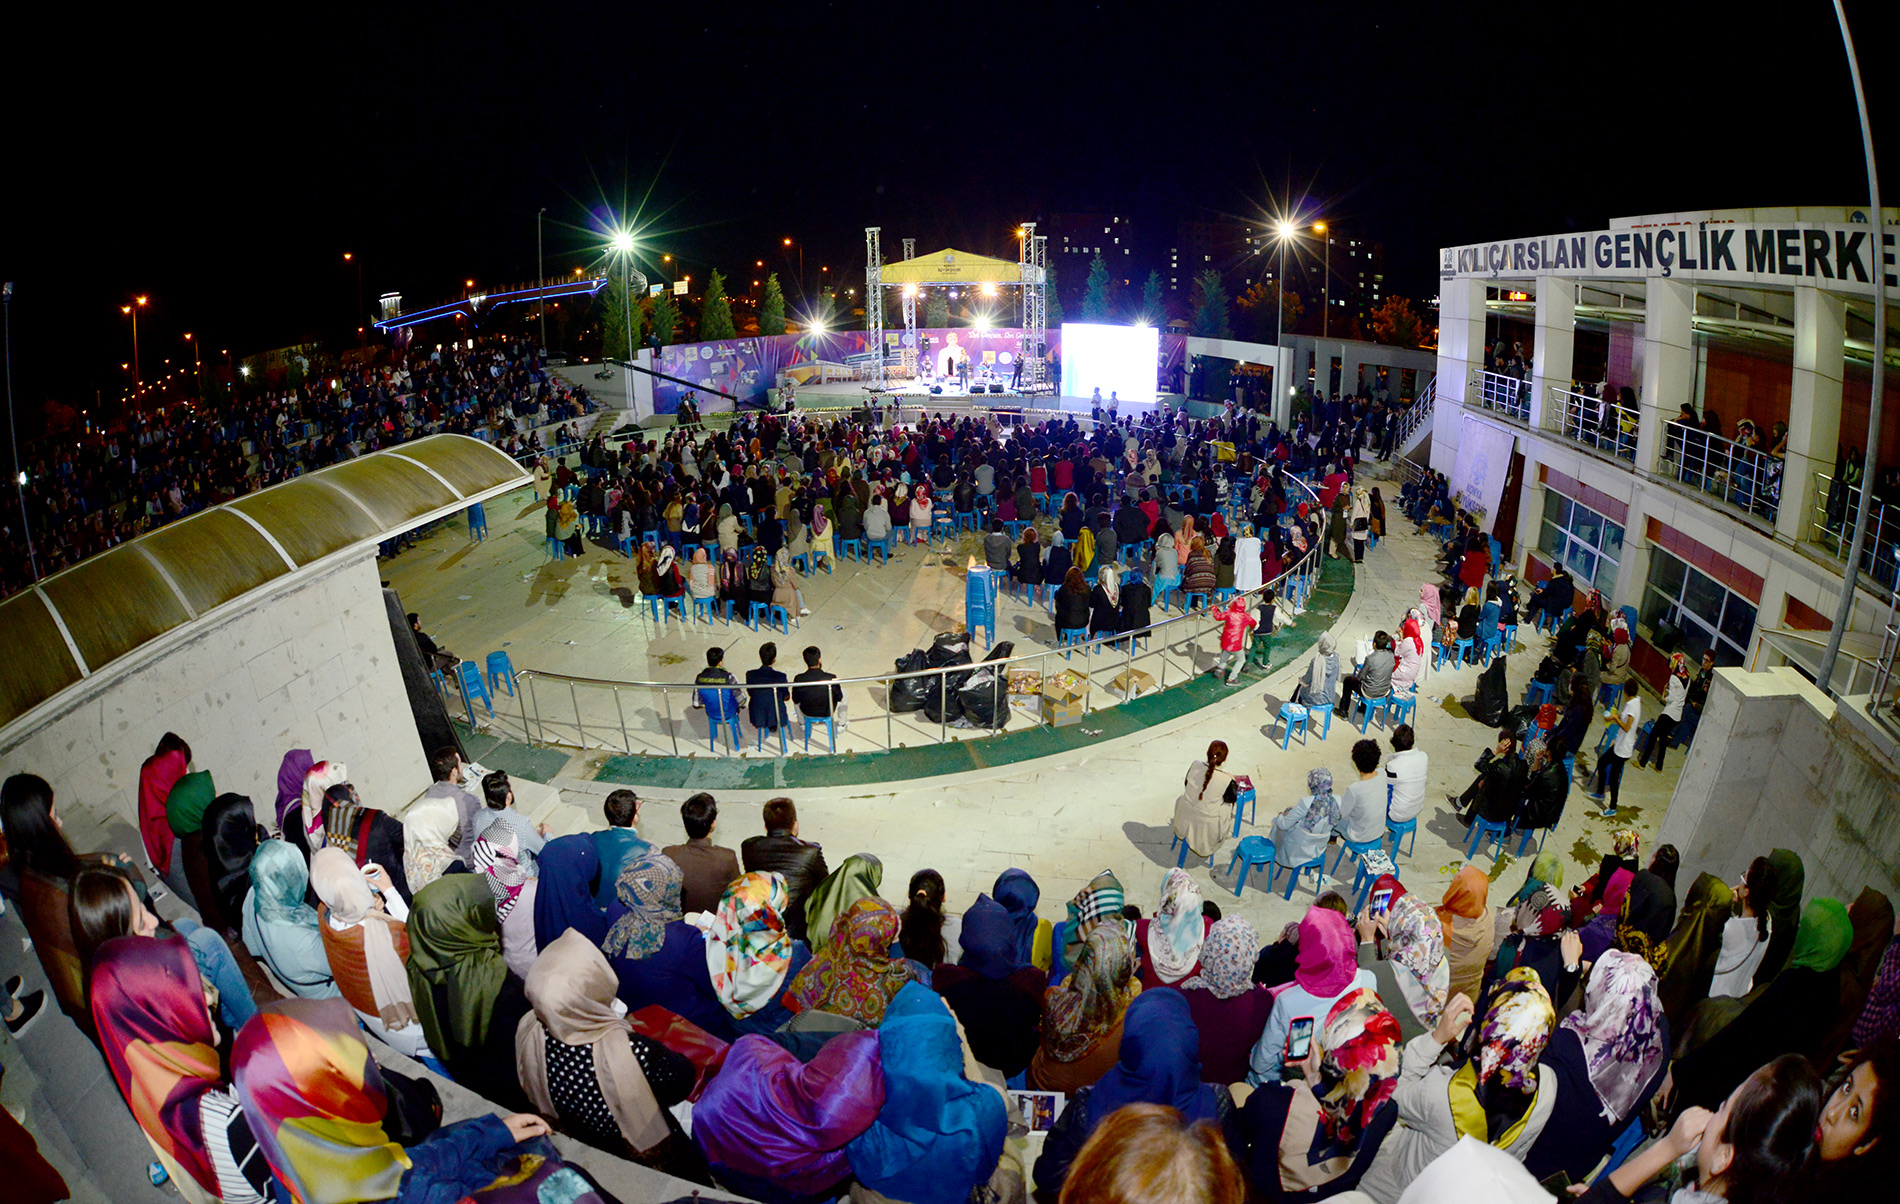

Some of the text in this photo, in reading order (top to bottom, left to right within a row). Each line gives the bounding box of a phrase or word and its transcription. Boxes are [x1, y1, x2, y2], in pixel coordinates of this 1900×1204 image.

[1457, 236, 1587, 278] KILIÇARSLAN
[1594, 222, 1737, 277] GENÇLİK
[1466, 484, 1483, 500] KONYA
